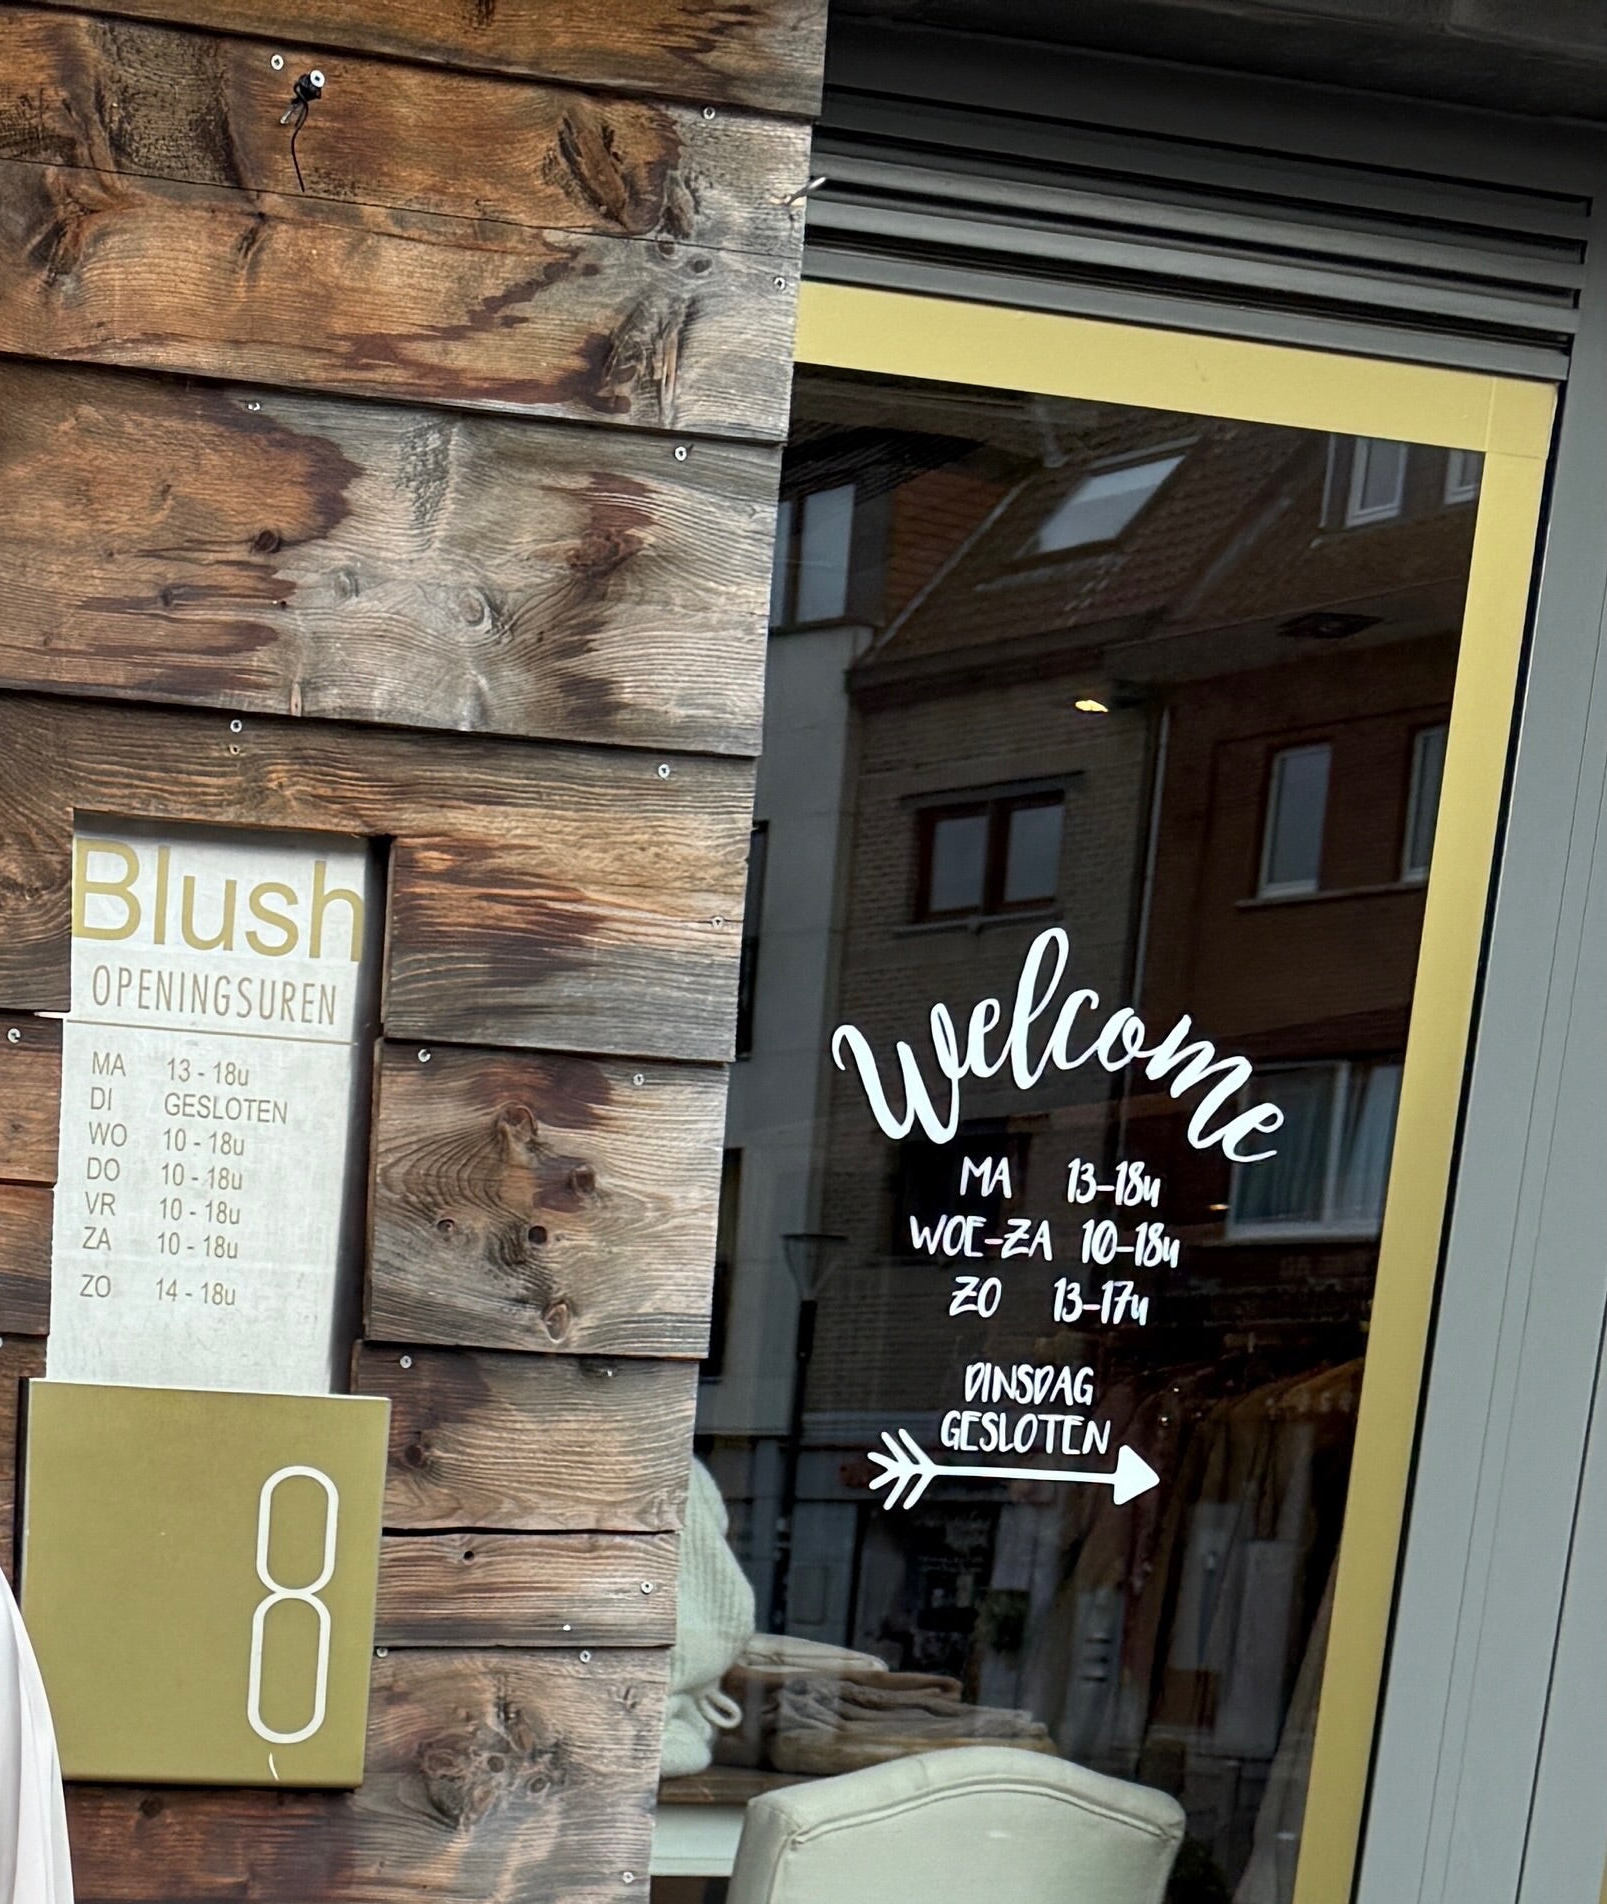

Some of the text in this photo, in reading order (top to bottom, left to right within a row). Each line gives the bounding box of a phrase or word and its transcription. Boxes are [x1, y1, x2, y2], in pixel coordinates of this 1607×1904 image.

[72, 840, 363, 962] Blush
[92, 965, 337, 1026] OPENINGSUREN
[832, 928, 1285, 1163] Welcome
[91, 1052, 127, 1078] MA
[166, 1057, 192, 1083] 13
[212, 1061, 250, 1088] 18u
[90, 1087, 289, 1125] DI GESLOTEN
[88, 1121, 129, 1148] WO
[163, 1128, 187, 1153] 10
[208, 1131, 246, 1157] 18u
[86, 1157, 122, 1183] DO
[161, 1162, 186, 1187] 10
[207, 1166, 244, 1191] 18u
[959, 1156, 1161, 1208] MA 13-18u
[84, 1192, 117, 1217] VR
[159, 1197, 183, 1222] 10
[204, 1200, 241, 1226] 18u
[81, 1226, 112, 1252] ZA
[157, 1231, 181, 1256] 10
[202, 1235, 239, 1260] 18u
[909, 1214, 1053, 1262] WOE-ZA
[79, 1274, 113, 1299] ZO
[155, 1278, 179, 1303] 14
[200, 1282, 237, 1307] 18u
[949, 1275, 1002, 1318] ZO
[964, 1361, 1094, 1406] DINSDAG
[940, 1411, 1111, 1455] GESLOTEN
[247, 1465, 339, 1744] 8
